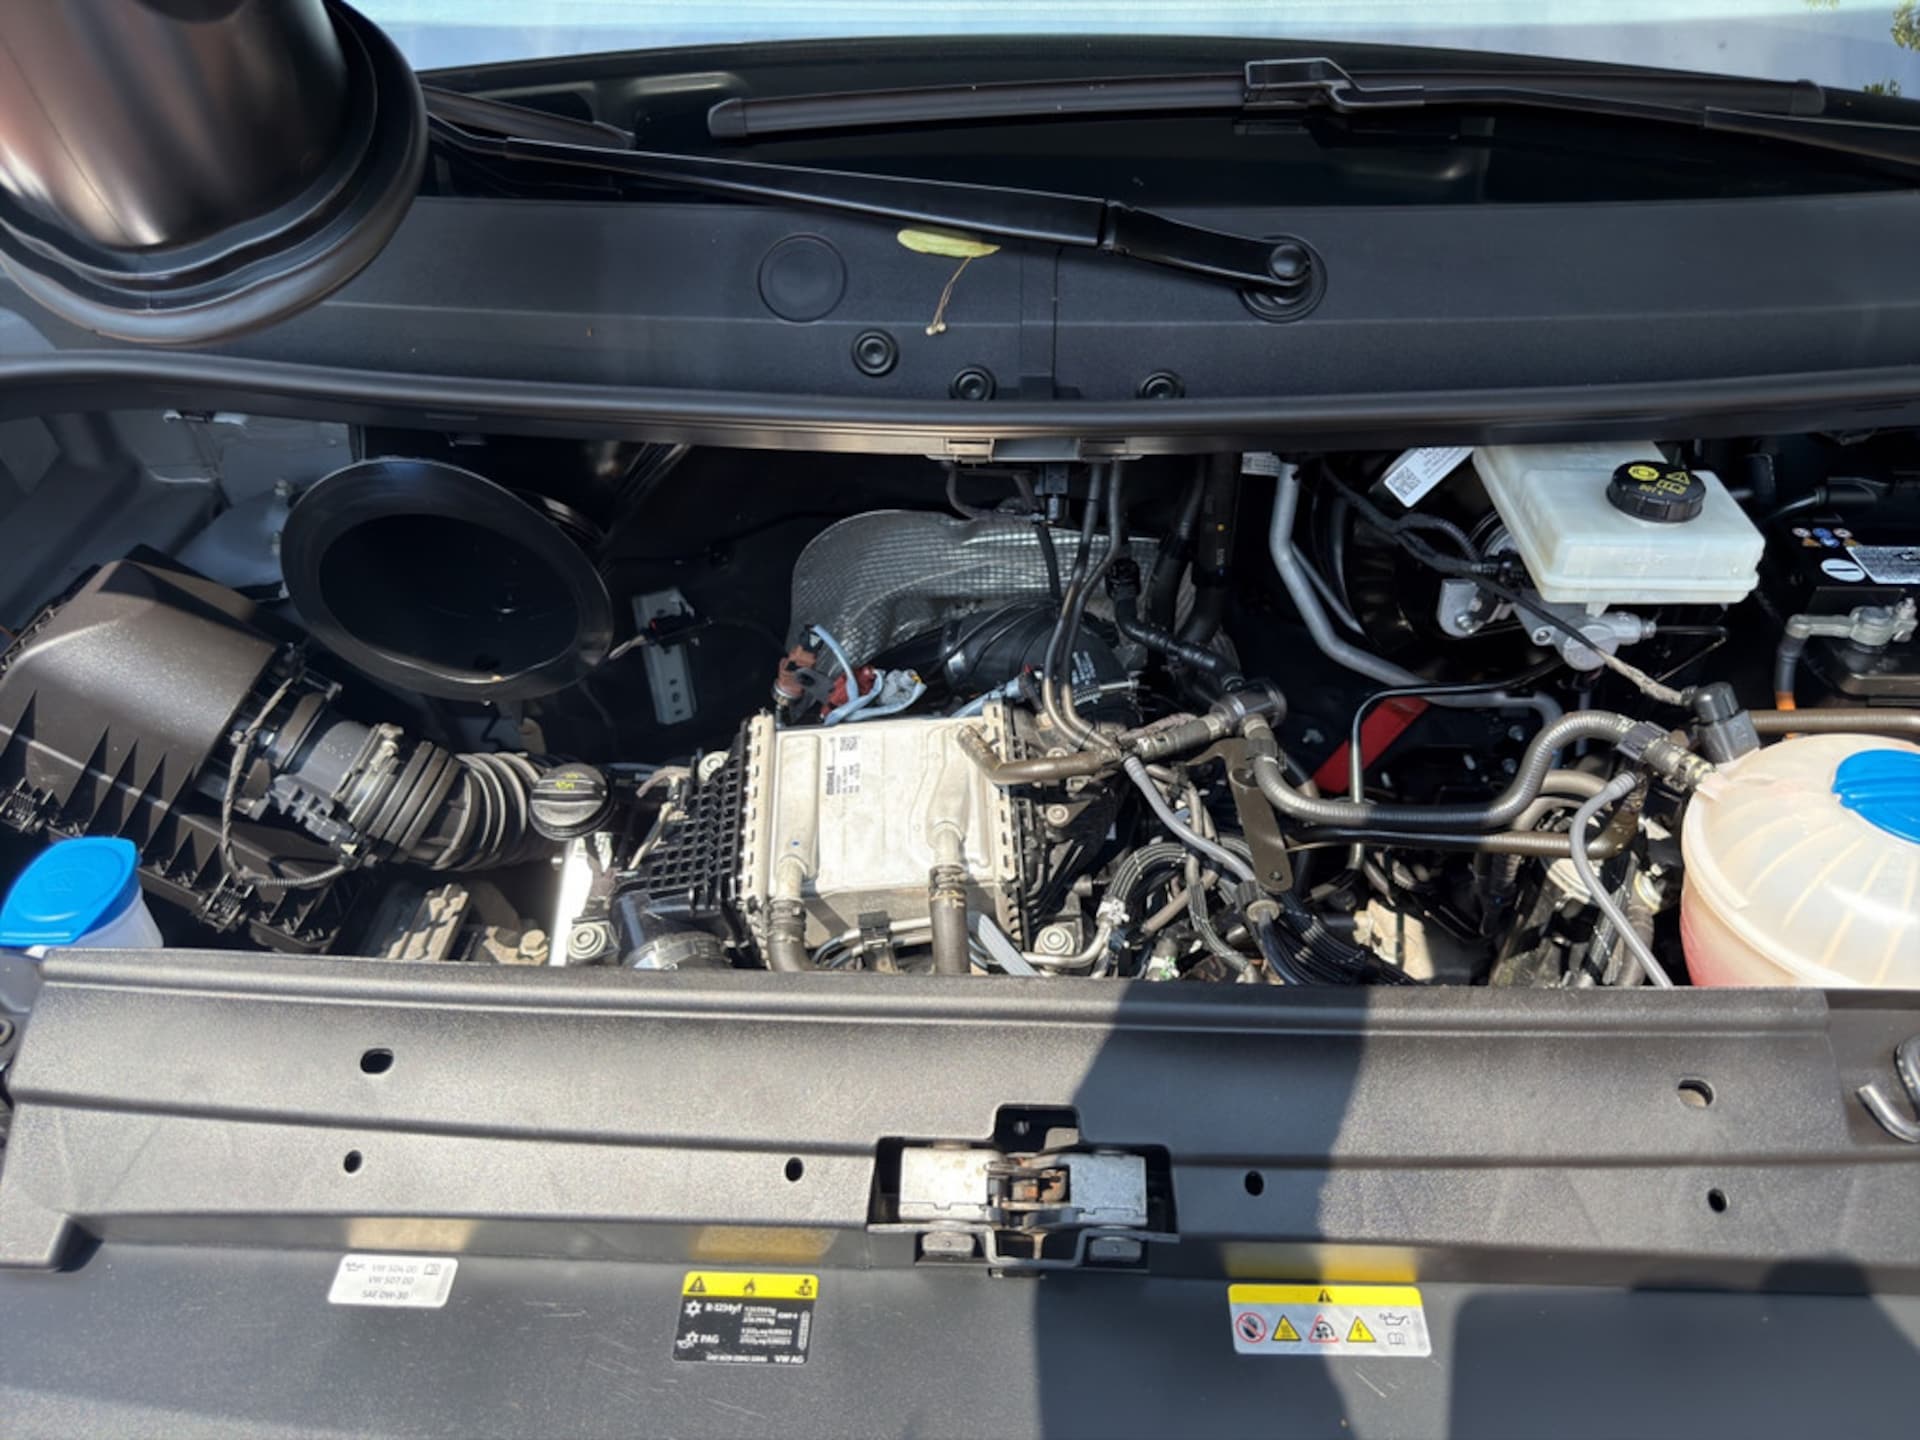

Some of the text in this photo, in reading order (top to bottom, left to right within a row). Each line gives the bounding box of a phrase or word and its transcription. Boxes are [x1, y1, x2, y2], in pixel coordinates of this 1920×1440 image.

[700, 1334, 720, 1344] PAG
[774, 1354, 790, 1362] VW
[790, 1355, 805, 1363] AG
